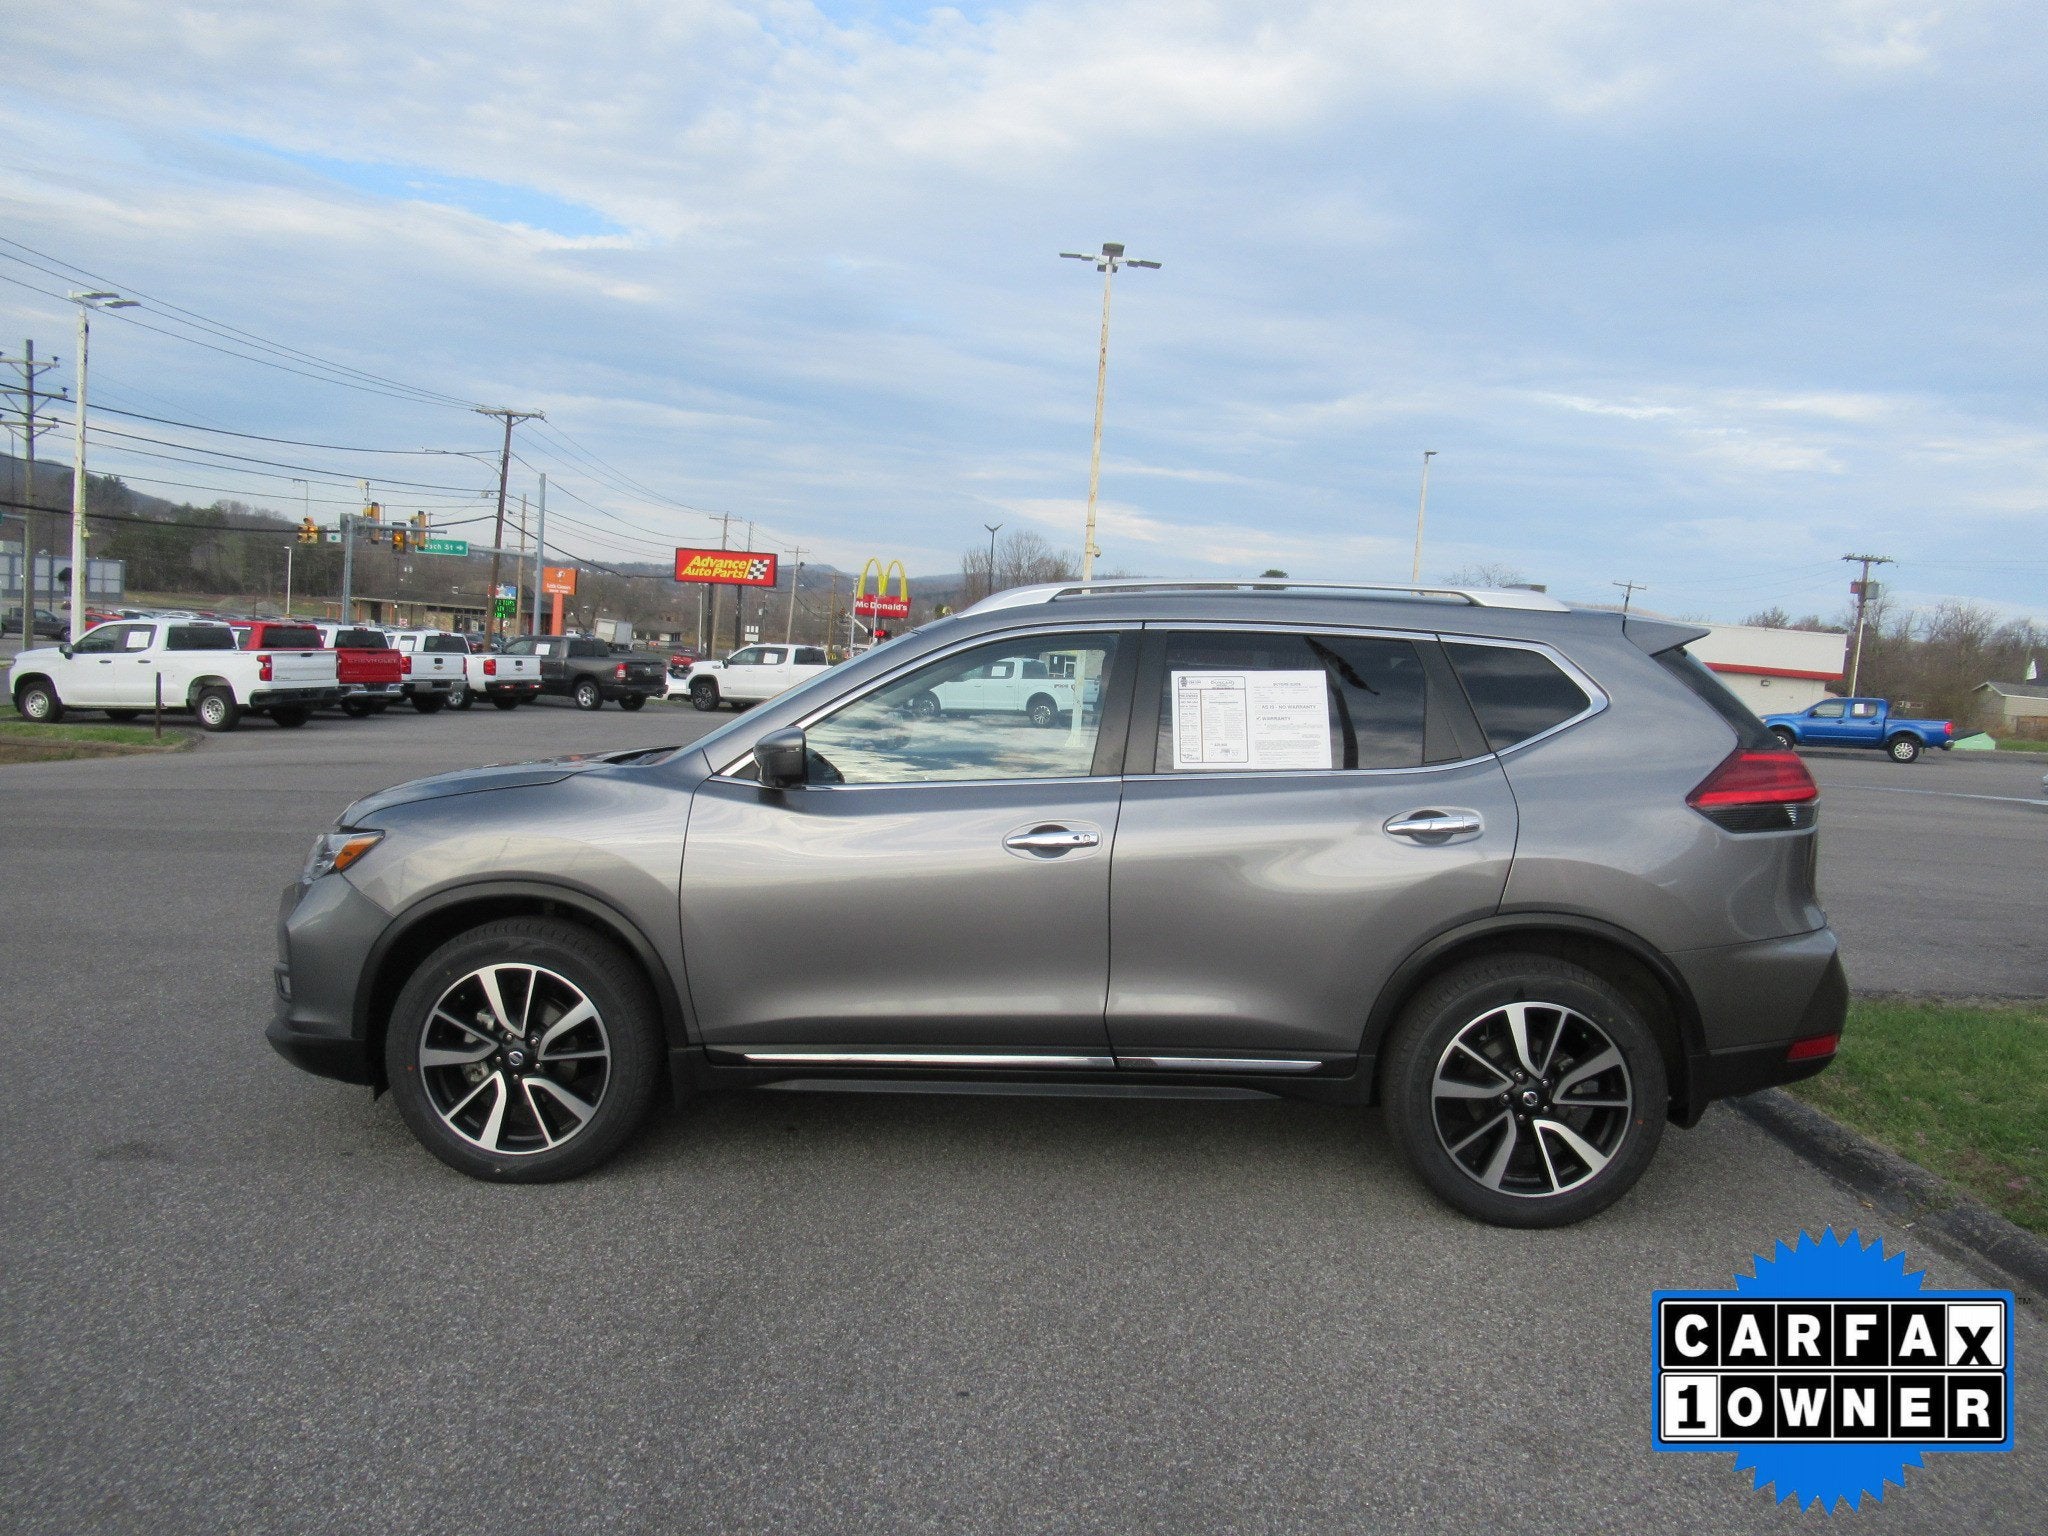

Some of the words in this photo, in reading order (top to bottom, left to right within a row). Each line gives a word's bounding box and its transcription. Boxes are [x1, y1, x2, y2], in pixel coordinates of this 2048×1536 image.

[689, 556, 746, 569] Advance
[682, 566, 712, 577] Auto
[712, 567, 744, 579] Parts
[855, 600, 908, 611] McDonald's
